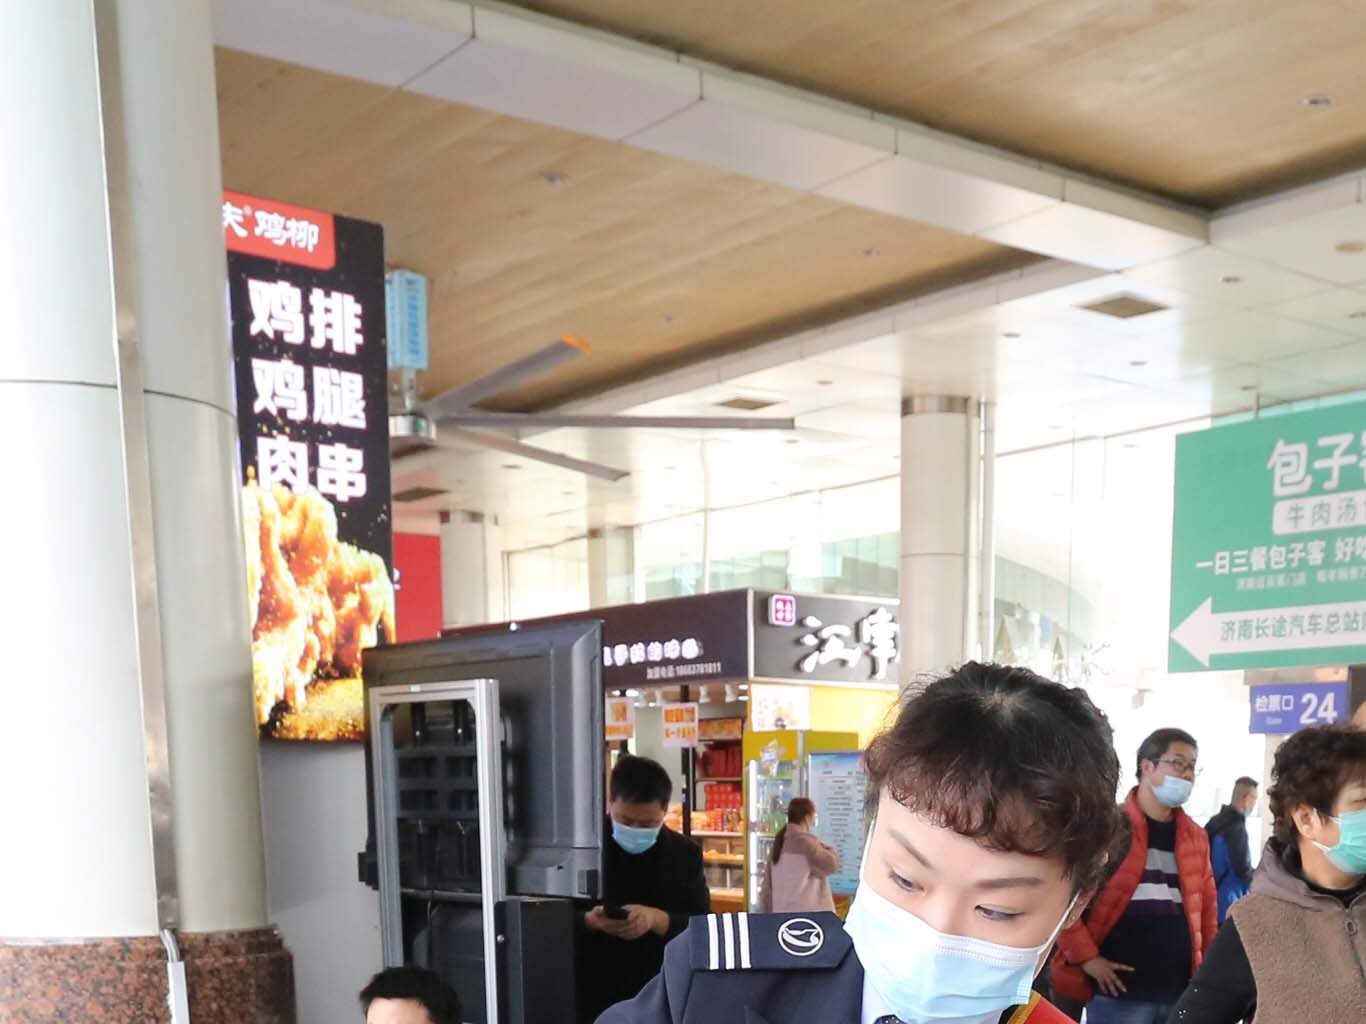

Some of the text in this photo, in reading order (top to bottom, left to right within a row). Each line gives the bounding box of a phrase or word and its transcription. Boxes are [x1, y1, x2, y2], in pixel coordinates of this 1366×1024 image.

[248, 277, 365, 356] 鸡排
[251, 358, 367, 430] 鸡腿
[257, 435, 367, 502] 肉串
[1299, 692, 1338, 724] 24
